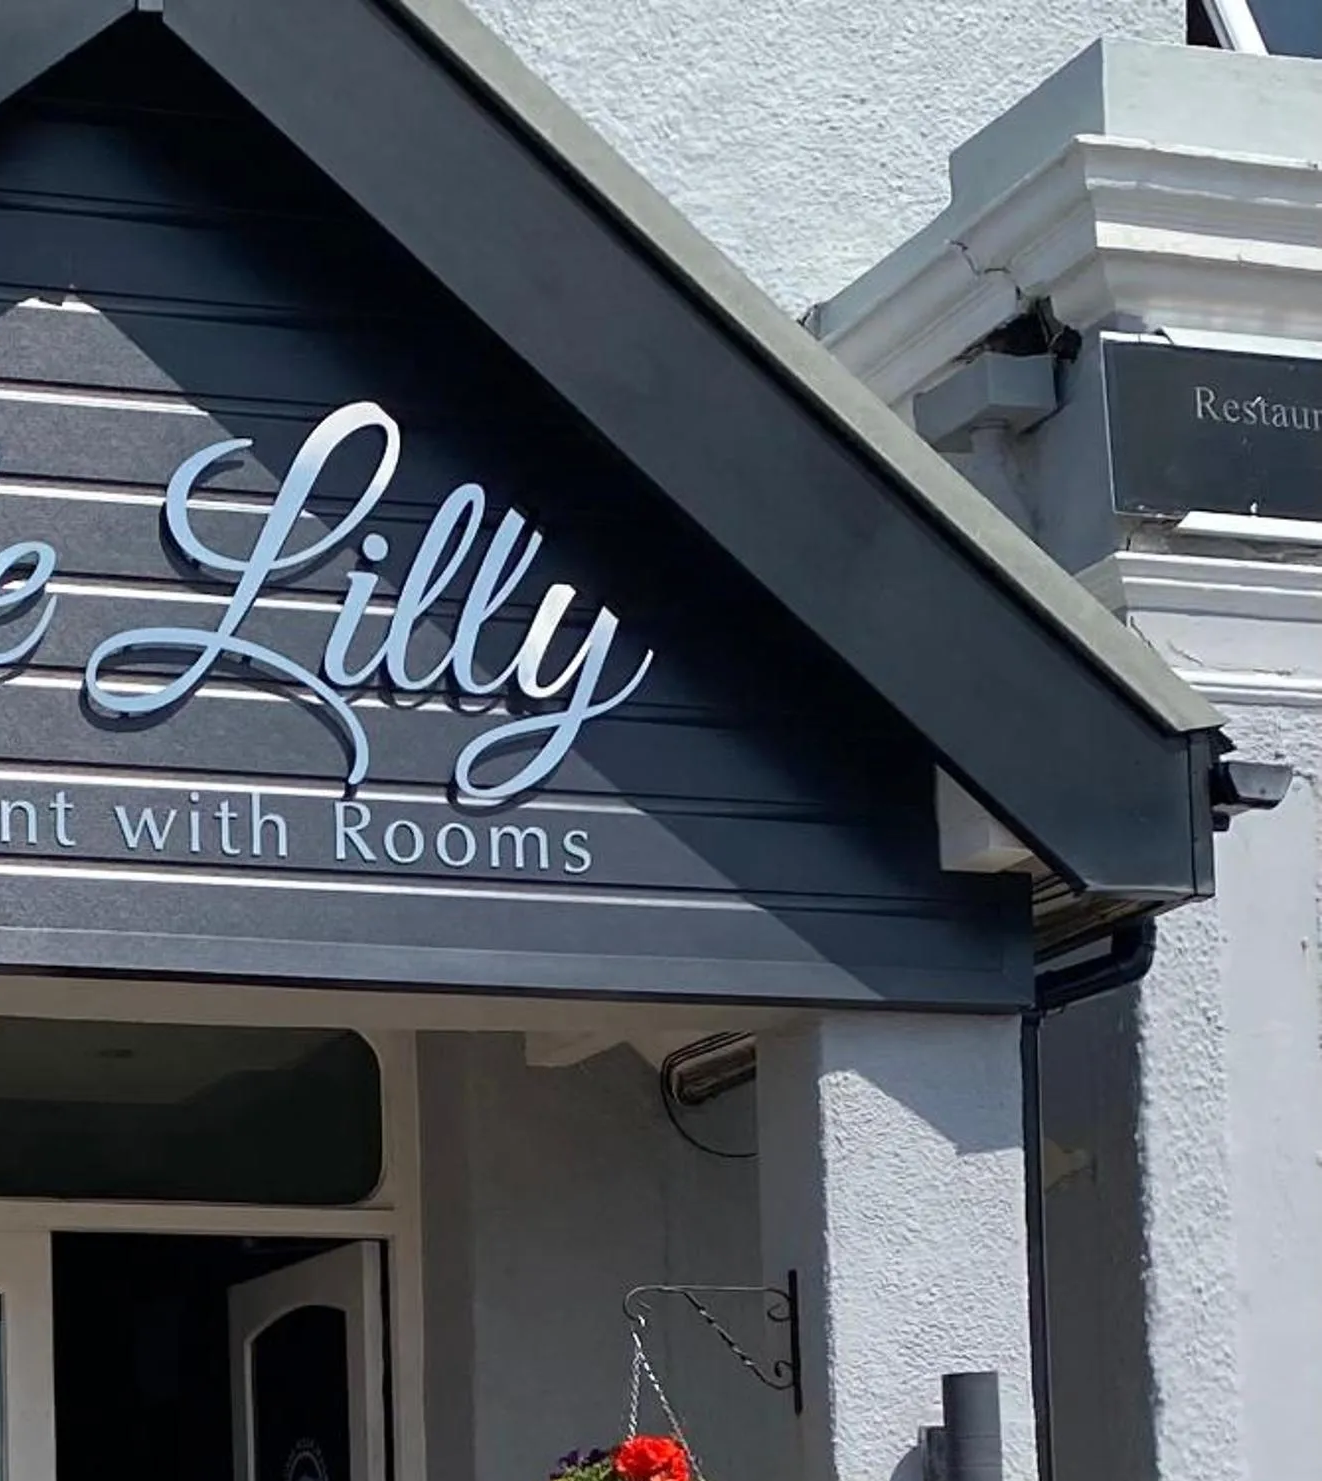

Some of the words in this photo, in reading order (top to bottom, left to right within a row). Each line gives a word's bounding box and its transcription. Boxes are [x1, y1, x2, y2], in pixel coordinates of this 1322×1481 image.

[85, 401, 654, 799] Lilly
[115, 792, 289, 858] with
[334, 800, 593, 873] Rooms
